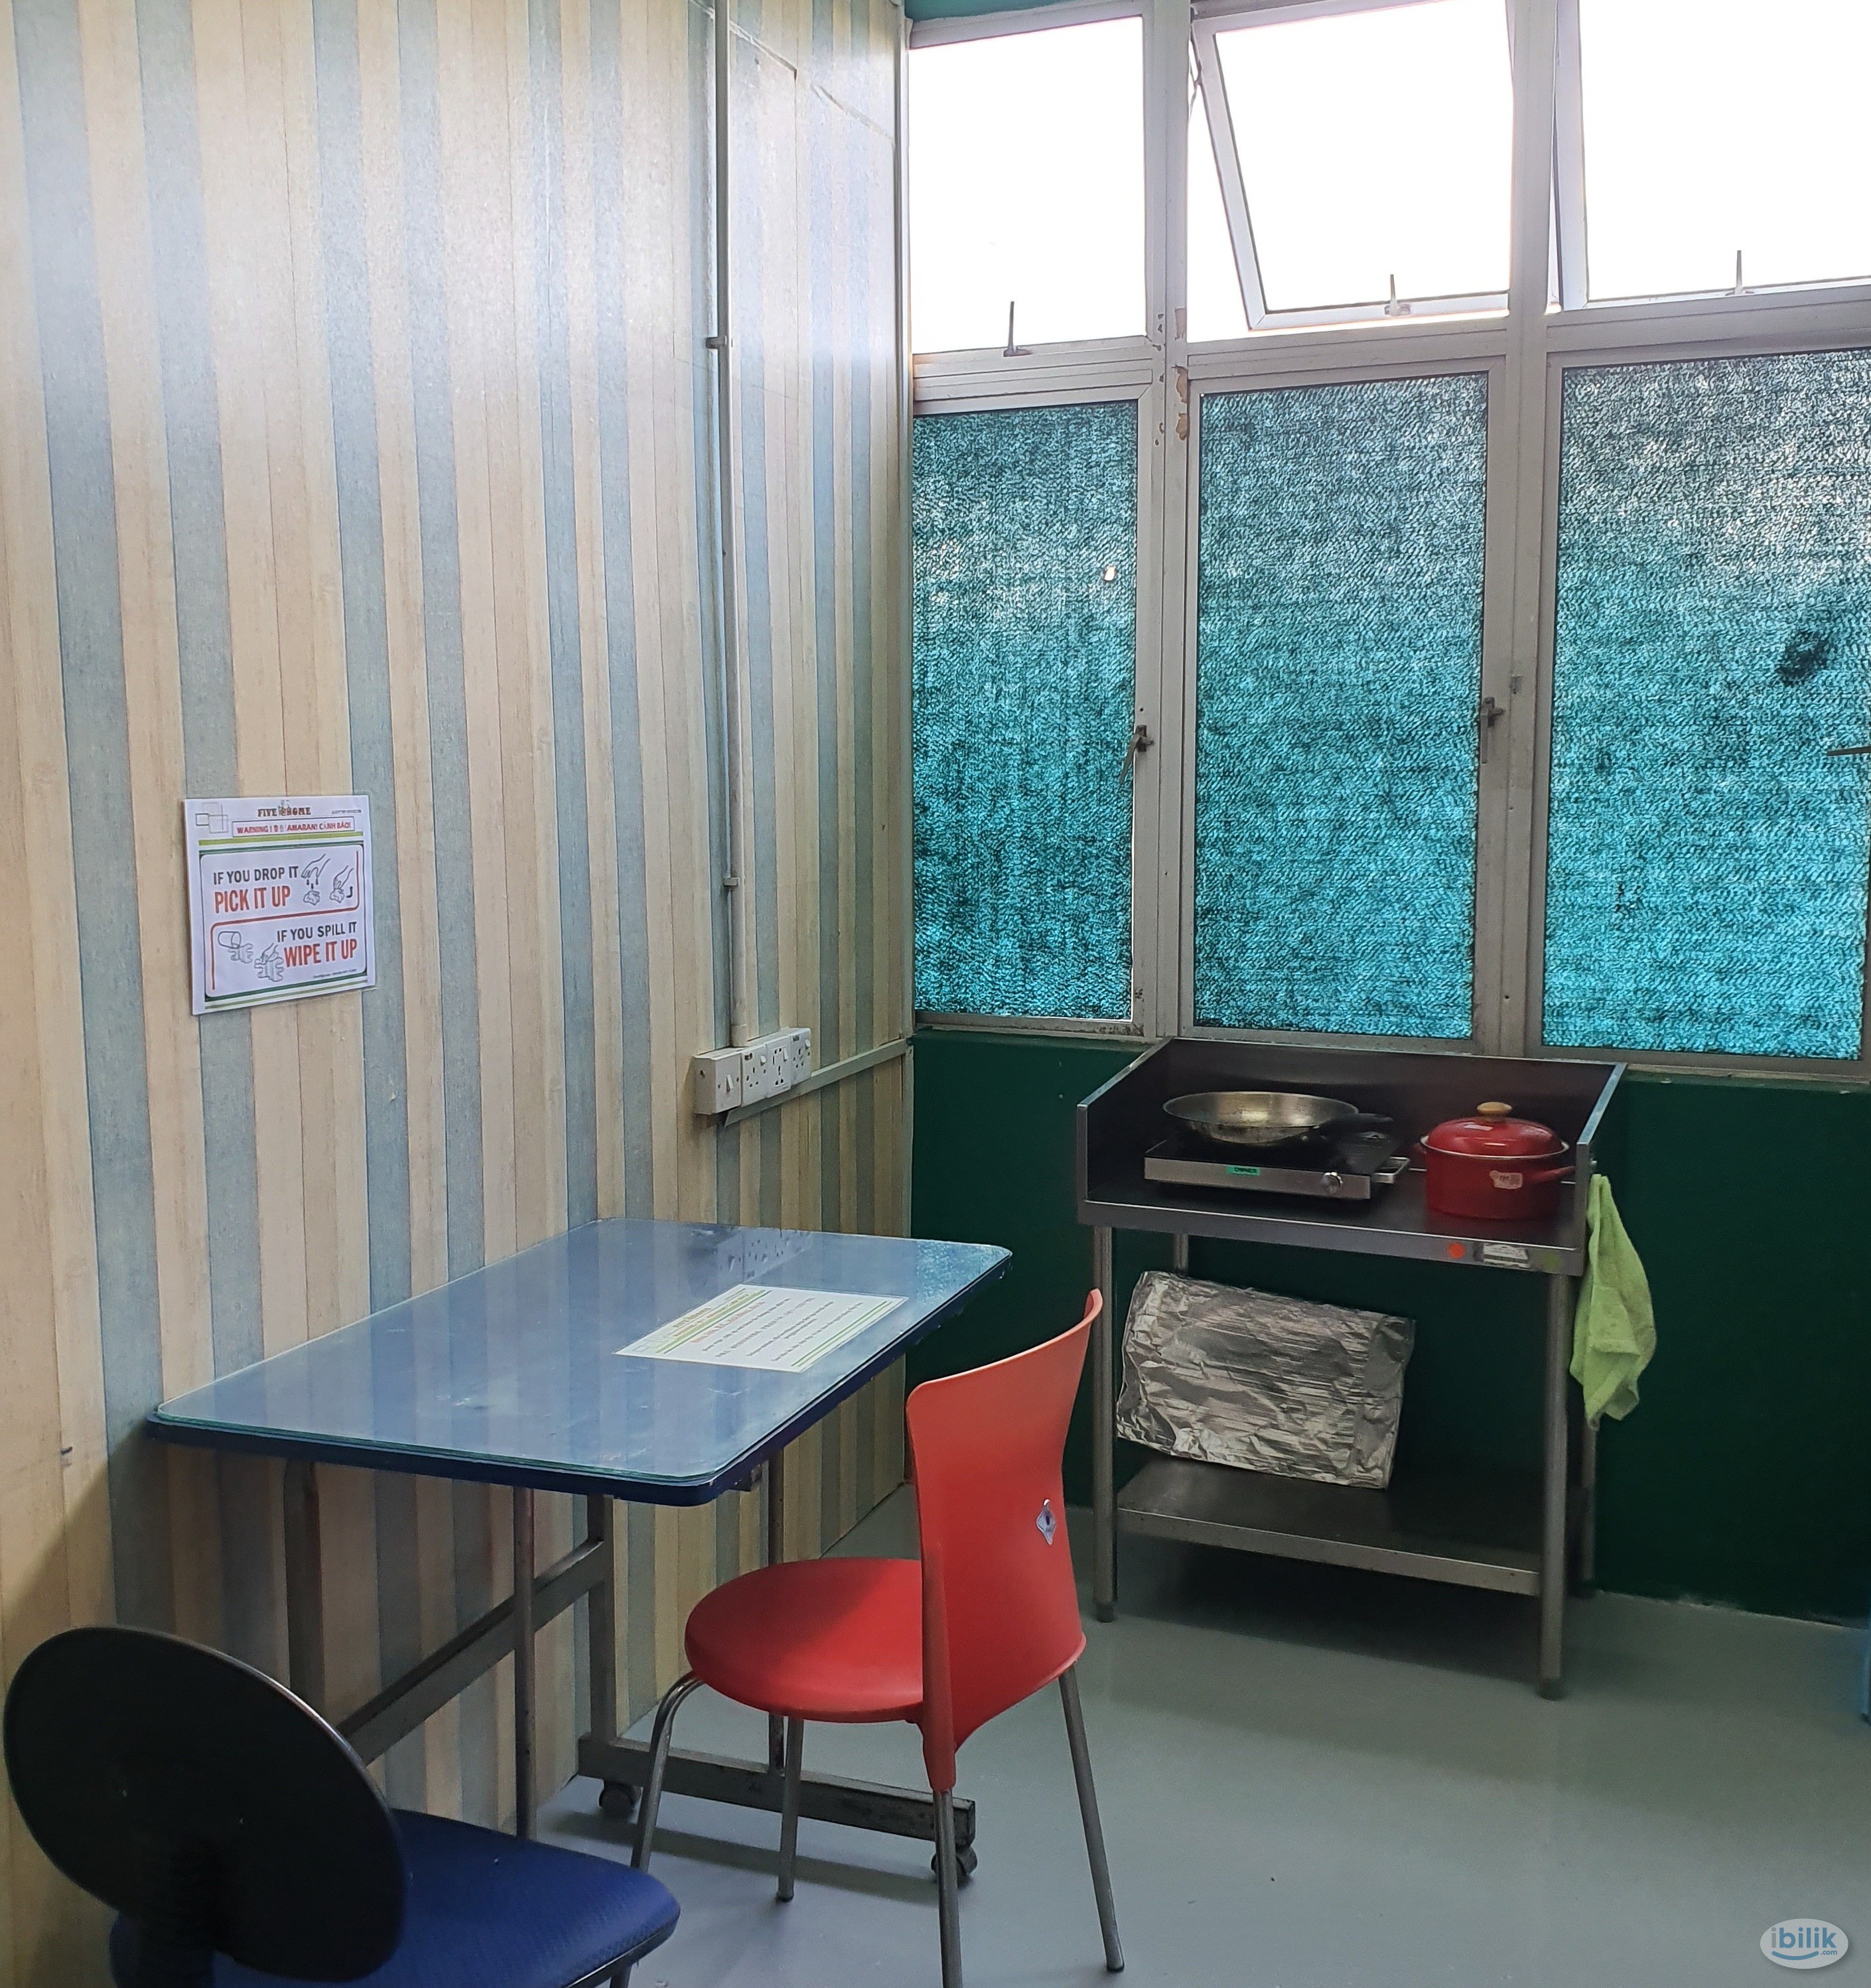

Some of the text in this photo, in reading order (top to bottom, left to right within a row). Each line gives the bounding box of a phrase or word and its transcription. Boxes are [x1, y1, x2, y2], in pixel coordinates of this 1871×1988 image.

[257, 808, 277, 817] FIVE
[237, 825, 268, 834] WARNING
[214, 866, 299, 885] IF YOU DROP IT
[214, 885, 291, 914] PICK IT UP
[277, 921, 357, 942] IF YOU SPILL IT
[283, 938, 357, 967] WIPE IT UP
